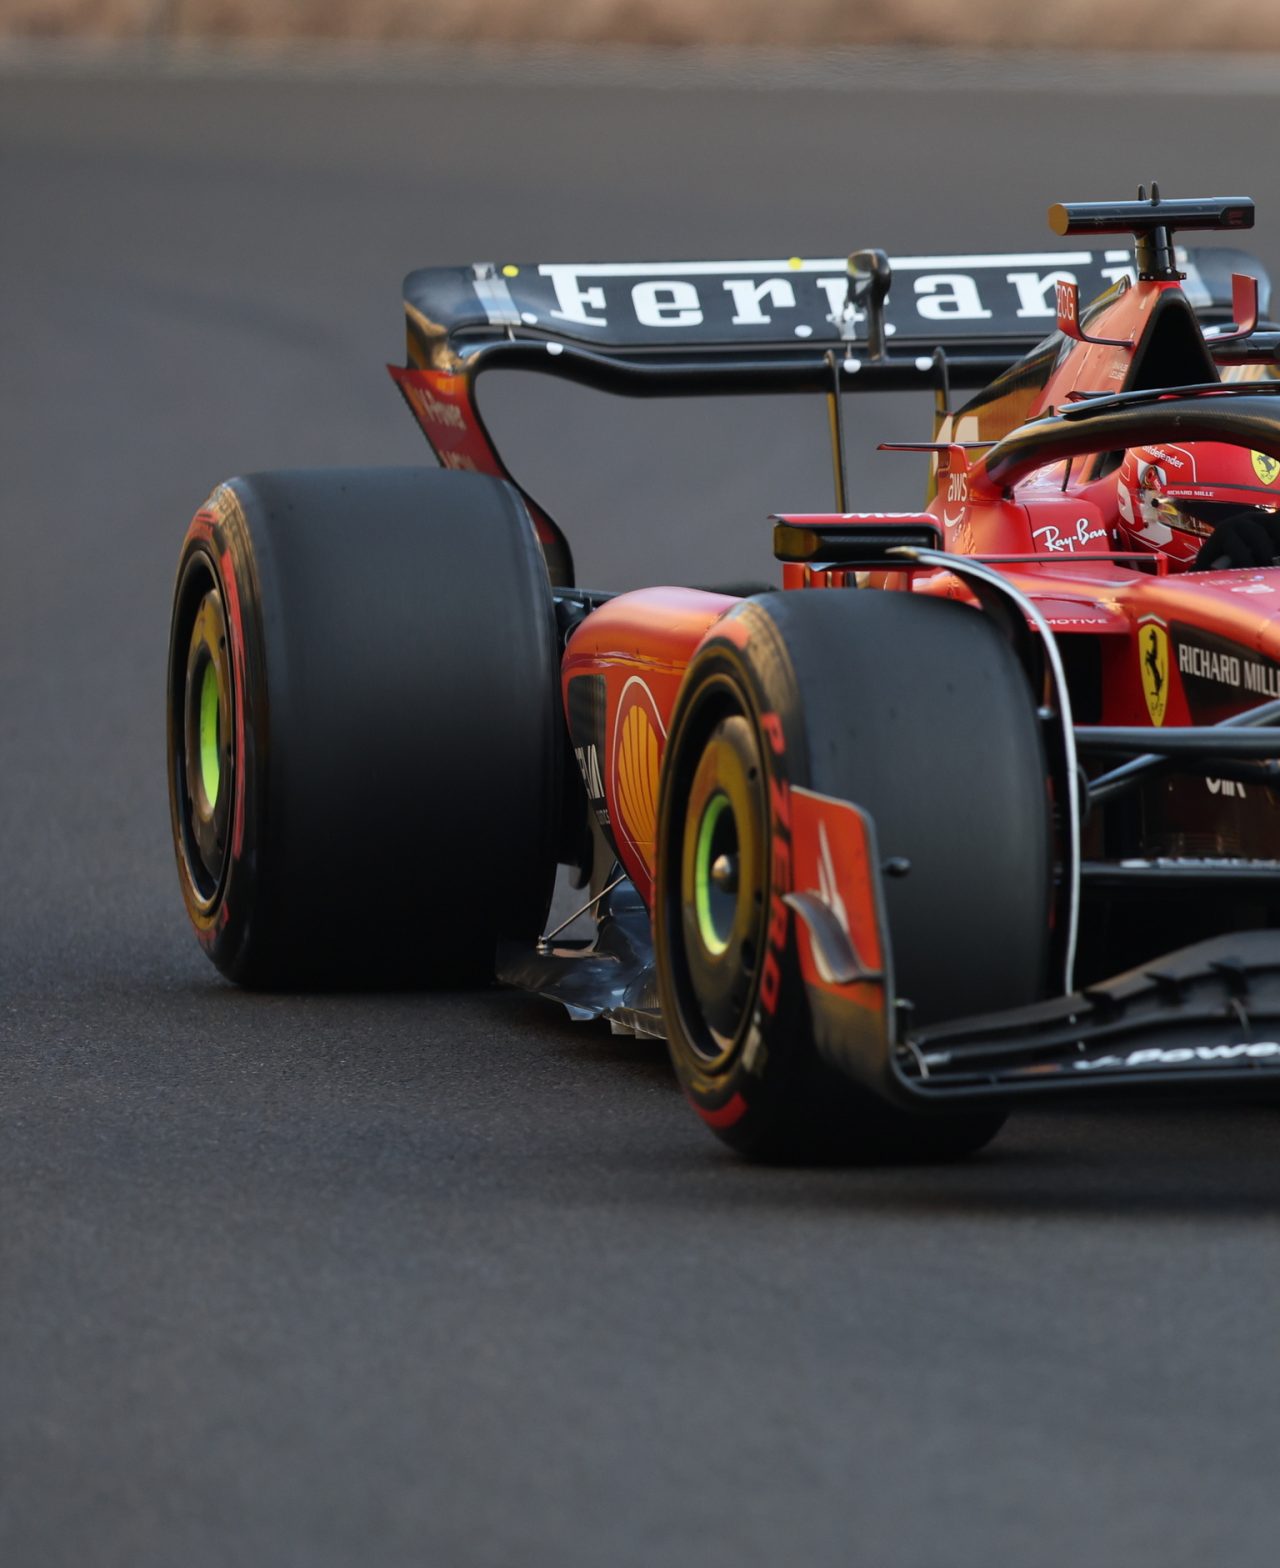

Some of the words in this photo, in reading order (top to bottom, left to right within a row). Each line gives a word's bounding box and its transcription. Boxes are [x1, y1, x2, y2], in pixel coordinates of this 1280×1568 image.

[946, 472, 969, 502] aws
[1032, 518, 1108, 552] Ray-Ban
[1178, 642, 1241, 688] RICHARD
